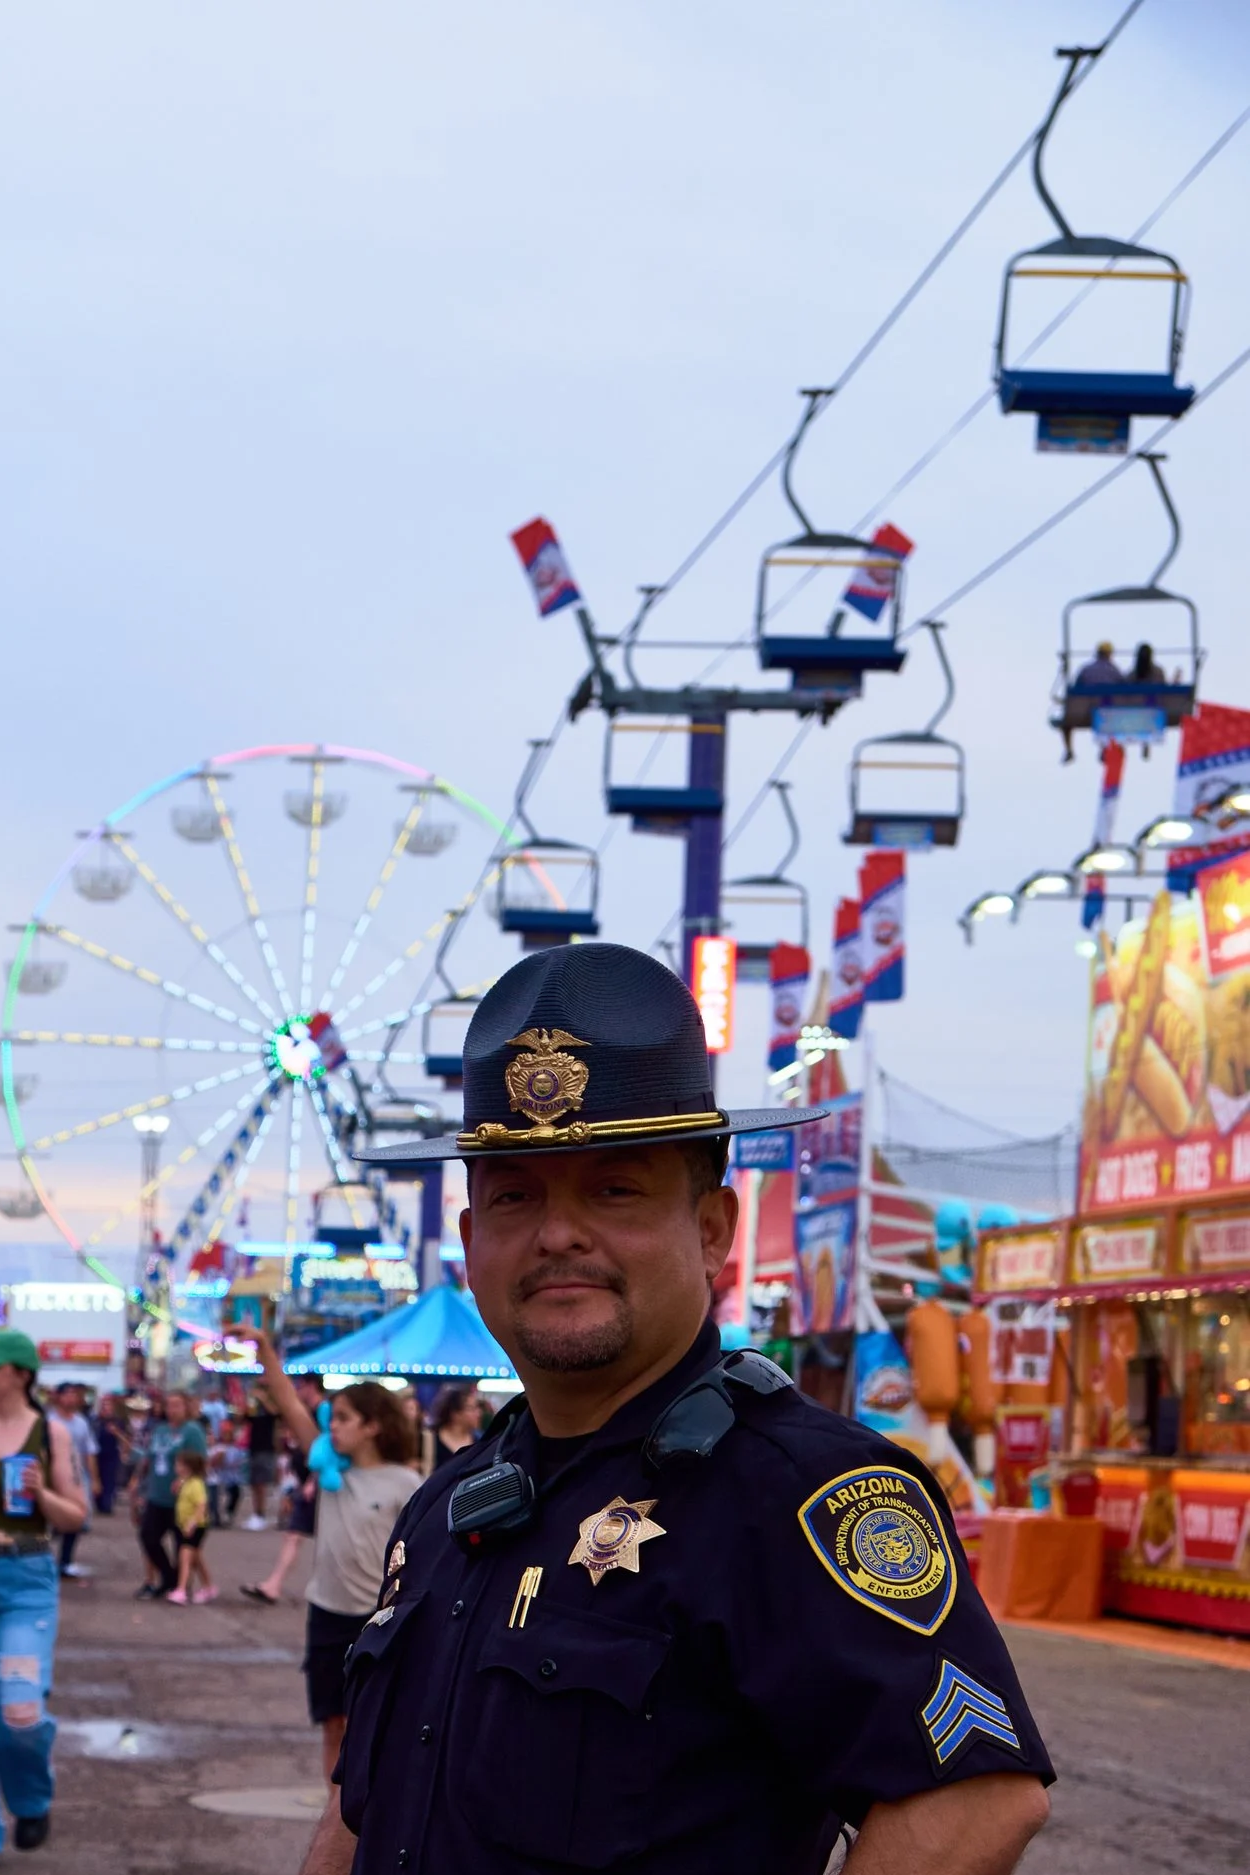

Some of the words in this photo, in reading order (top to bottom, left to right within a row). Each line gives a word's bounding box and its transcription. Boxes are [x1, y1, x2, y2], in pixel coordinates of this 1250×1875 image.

[521, 1099, 568, 1112] ARIZONA
[10, 1282, 126, 1312] TICKETS
[825, 1477, 907, 1515] ARIZONA
[835, 1508, 861, 1567] DEPARTMENT
[857, 1499, 871, 1512] OF
[872, 1496, 940, 1545] TRANSPORTATION
[867, 1565, 944, 1597] ENFORCEMENT
